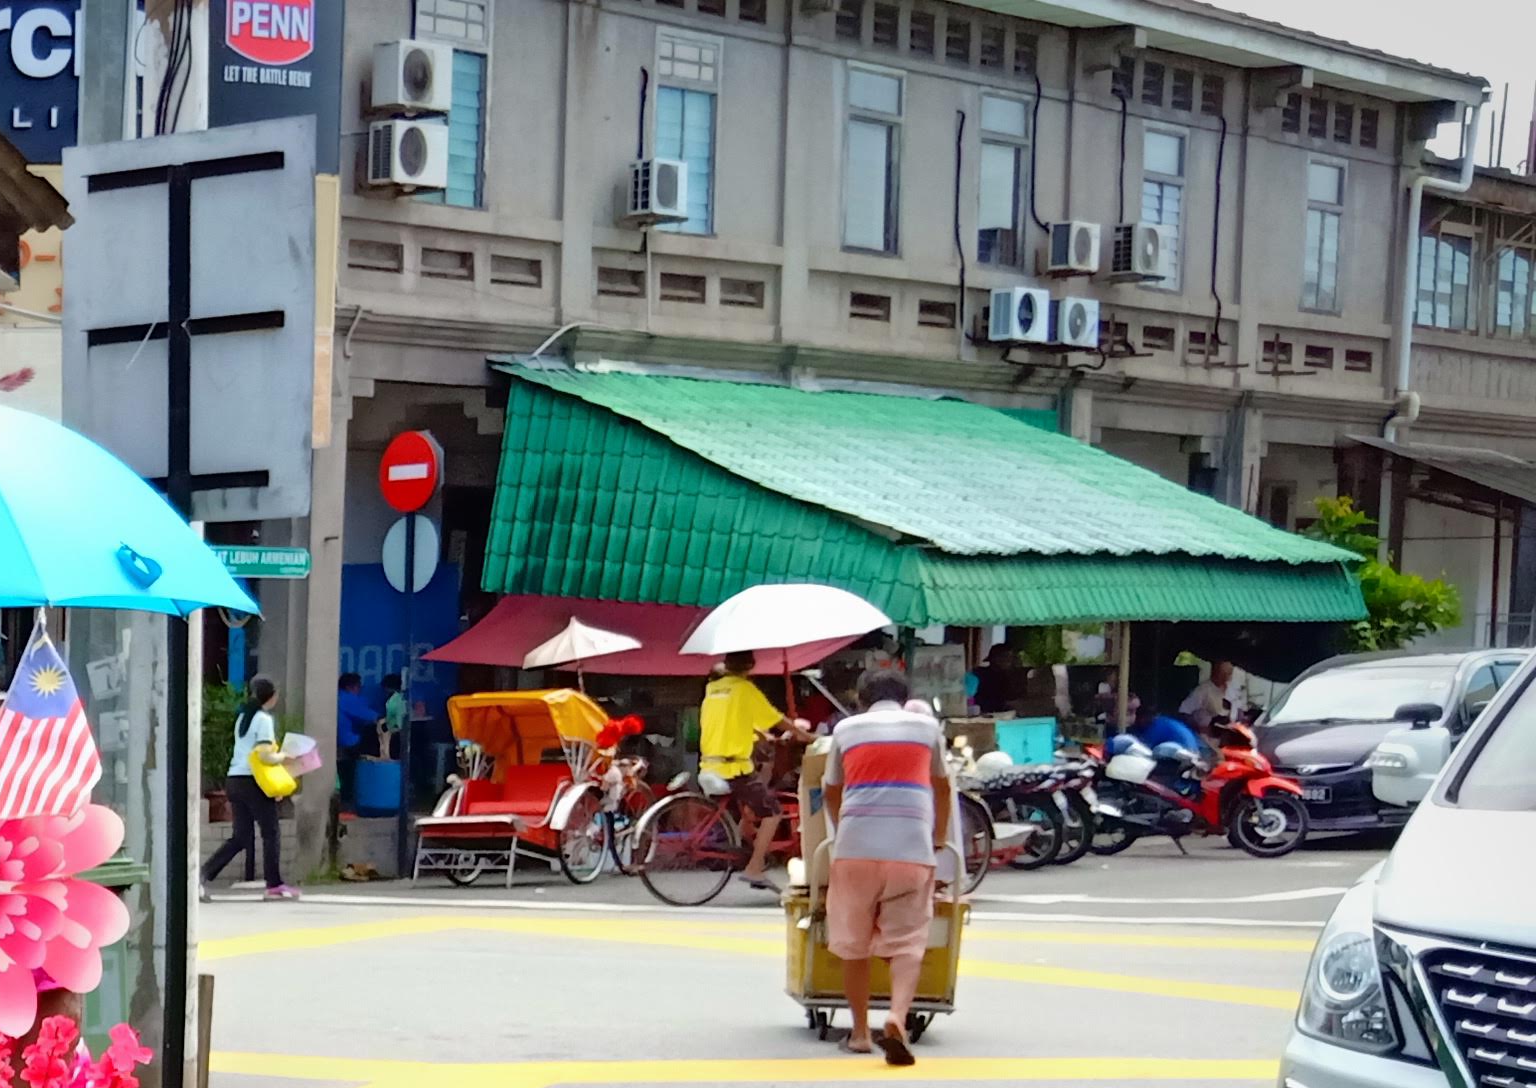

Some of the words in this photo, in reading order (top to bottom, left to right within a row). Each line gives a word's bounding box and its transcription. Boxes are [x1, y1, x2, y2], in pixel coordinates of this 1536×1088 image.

[231, 1, 310, 43] PENN
[223, 65, 240, 82] LET
[242, 66, 258, 83] THE
[259, 67, 287, 86] BATTLE
[12, 106, 58, 128] LI
[229, 551, 259, 565] LEBUH
[260, 551, 307, 566] ARMENIAN
